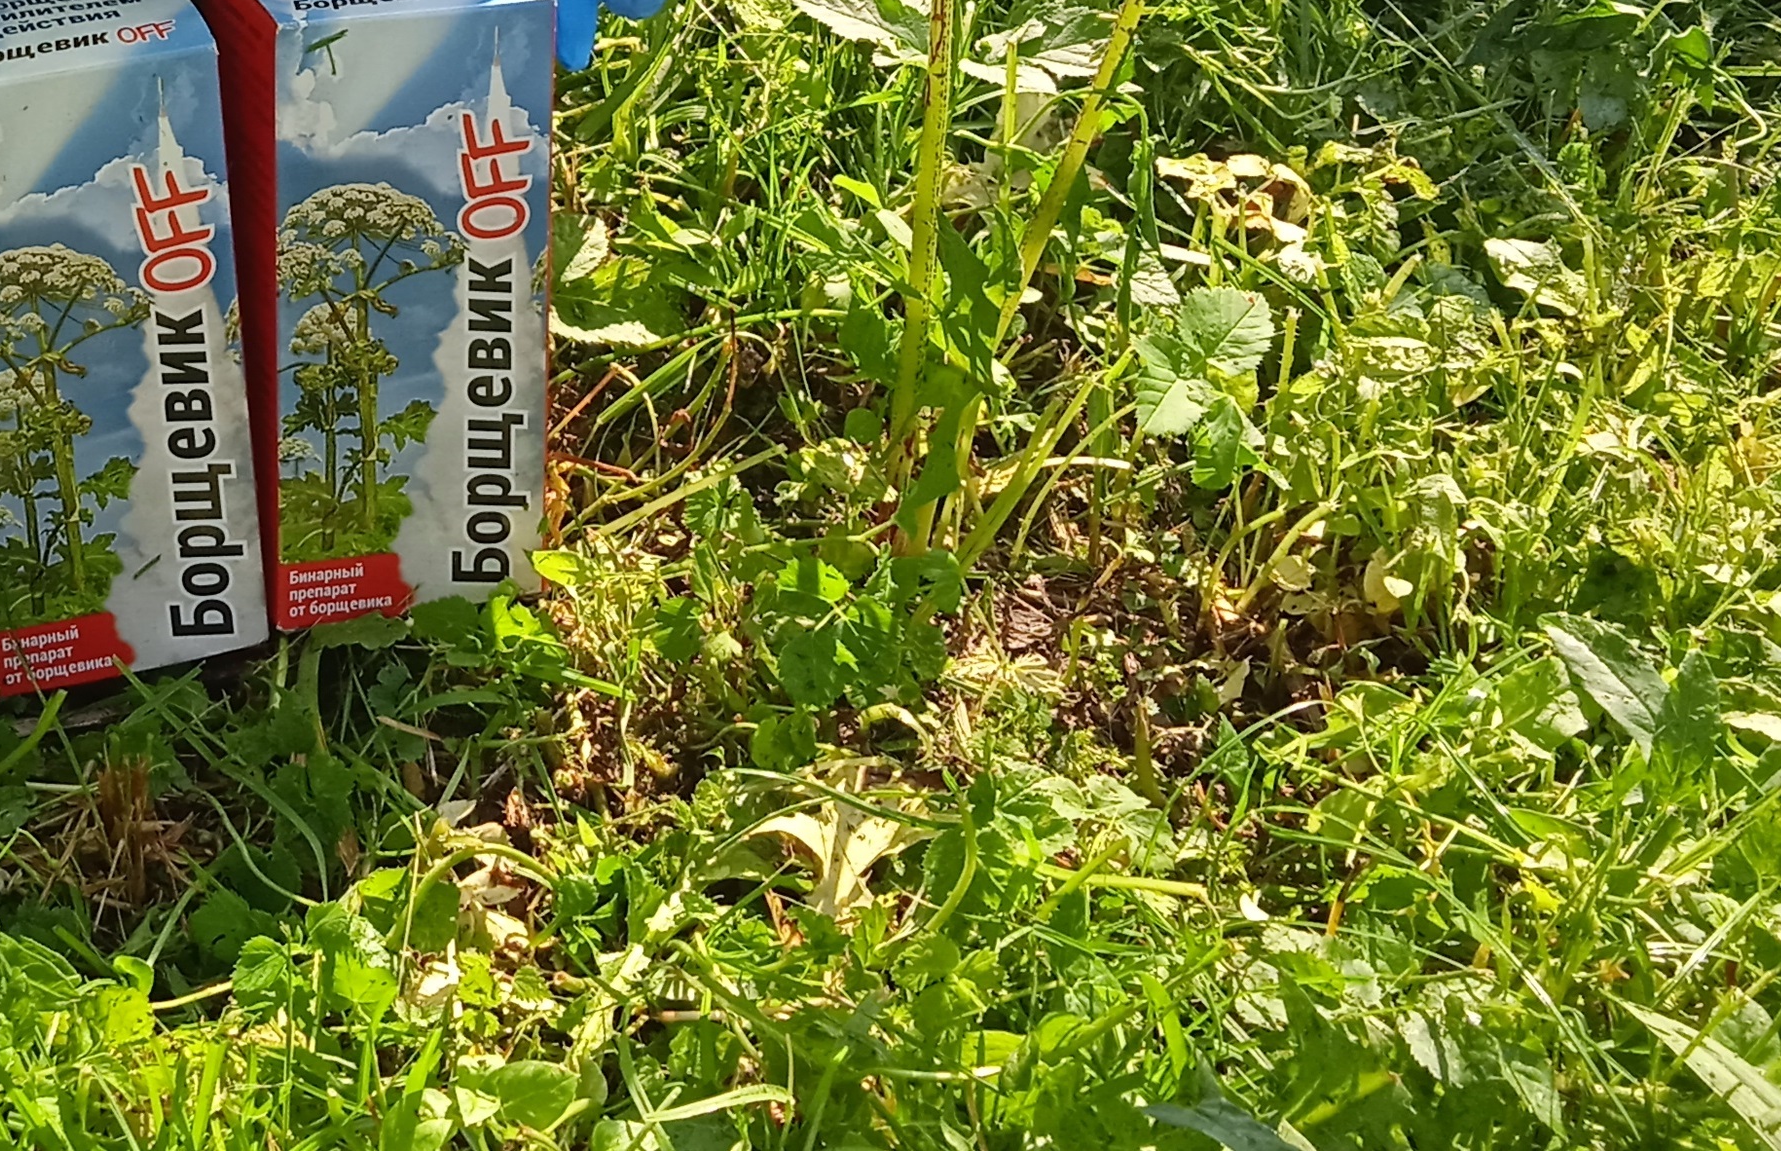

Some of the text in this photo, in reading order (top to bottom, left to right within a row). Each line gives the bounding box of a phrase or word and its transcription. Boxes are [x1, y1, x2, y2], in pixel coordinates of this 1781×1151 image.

[116, 20, 176, 45] OFF
[452, 113, 529, 584] Борщевик OFF
[133, 166, 242, 639] Борщевик OFF
[289, 562, 364, 585] Бинарный
[289, 583, 357, 603] препарат
[289, 595, 392, 618] от борщевика
[5, 671, 23, 684] от
